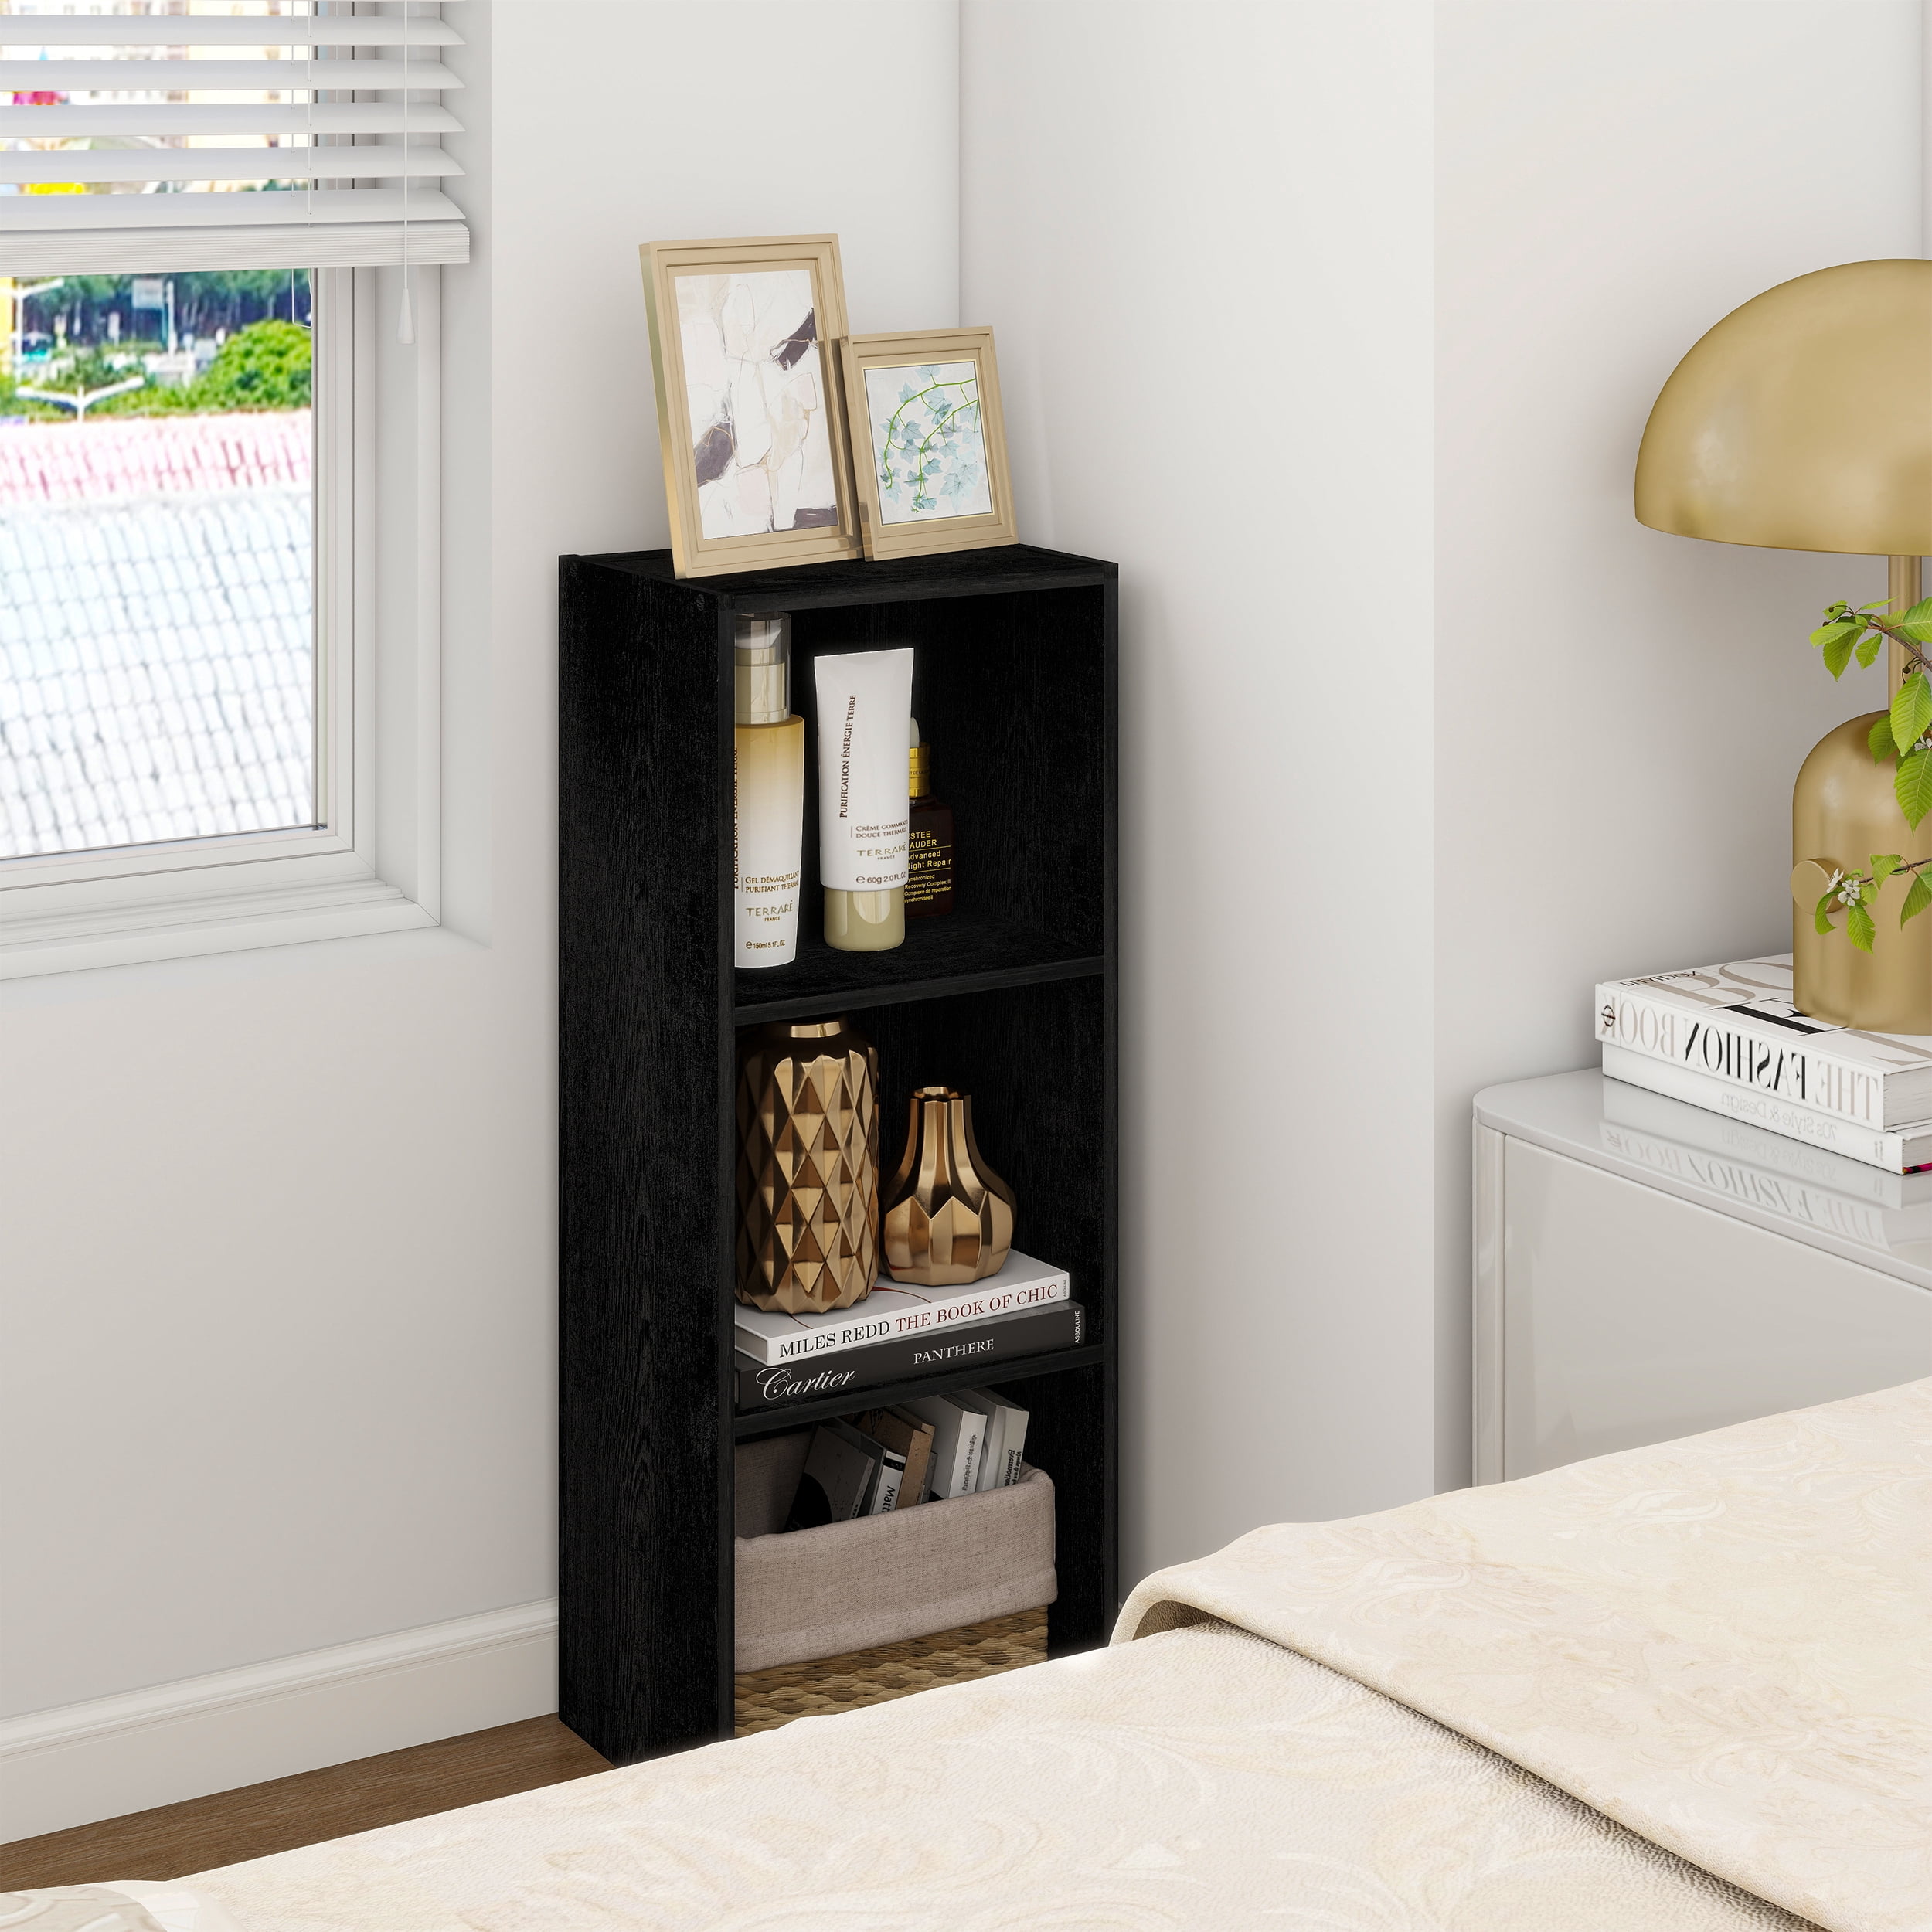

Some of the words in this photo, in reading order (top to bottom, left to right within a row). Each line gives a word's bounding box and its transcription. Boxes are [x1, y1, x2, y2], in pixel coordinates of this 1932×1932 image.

[839, 760, 849, 818] PURIFICATION
[846, 695, 856, 721] TERRE
[909, 831, 931, 840] STEE
[909, 839, 937, 849] AUDER
[927, 858, 951, 868] Repair
[866, 876, 883, 885] 60g
[745, 885, 780, 893] PURIFIANT
[779, 1332, 836, 1359] MILES
[840, 1321, 890, 1345] REDD
[895, 1312, 936, 1332] THE
[936, 1300, 985, 1324] BOOK
[989, 1294, 1012, 1311] OF
[1016, 1284, 1058, 1305] CHIC
[756, 1367, 856, 1400] Cartier
[913, 1338, 995, 1365] PANTHERE
[881, 1485, 896, 1513] Matt
